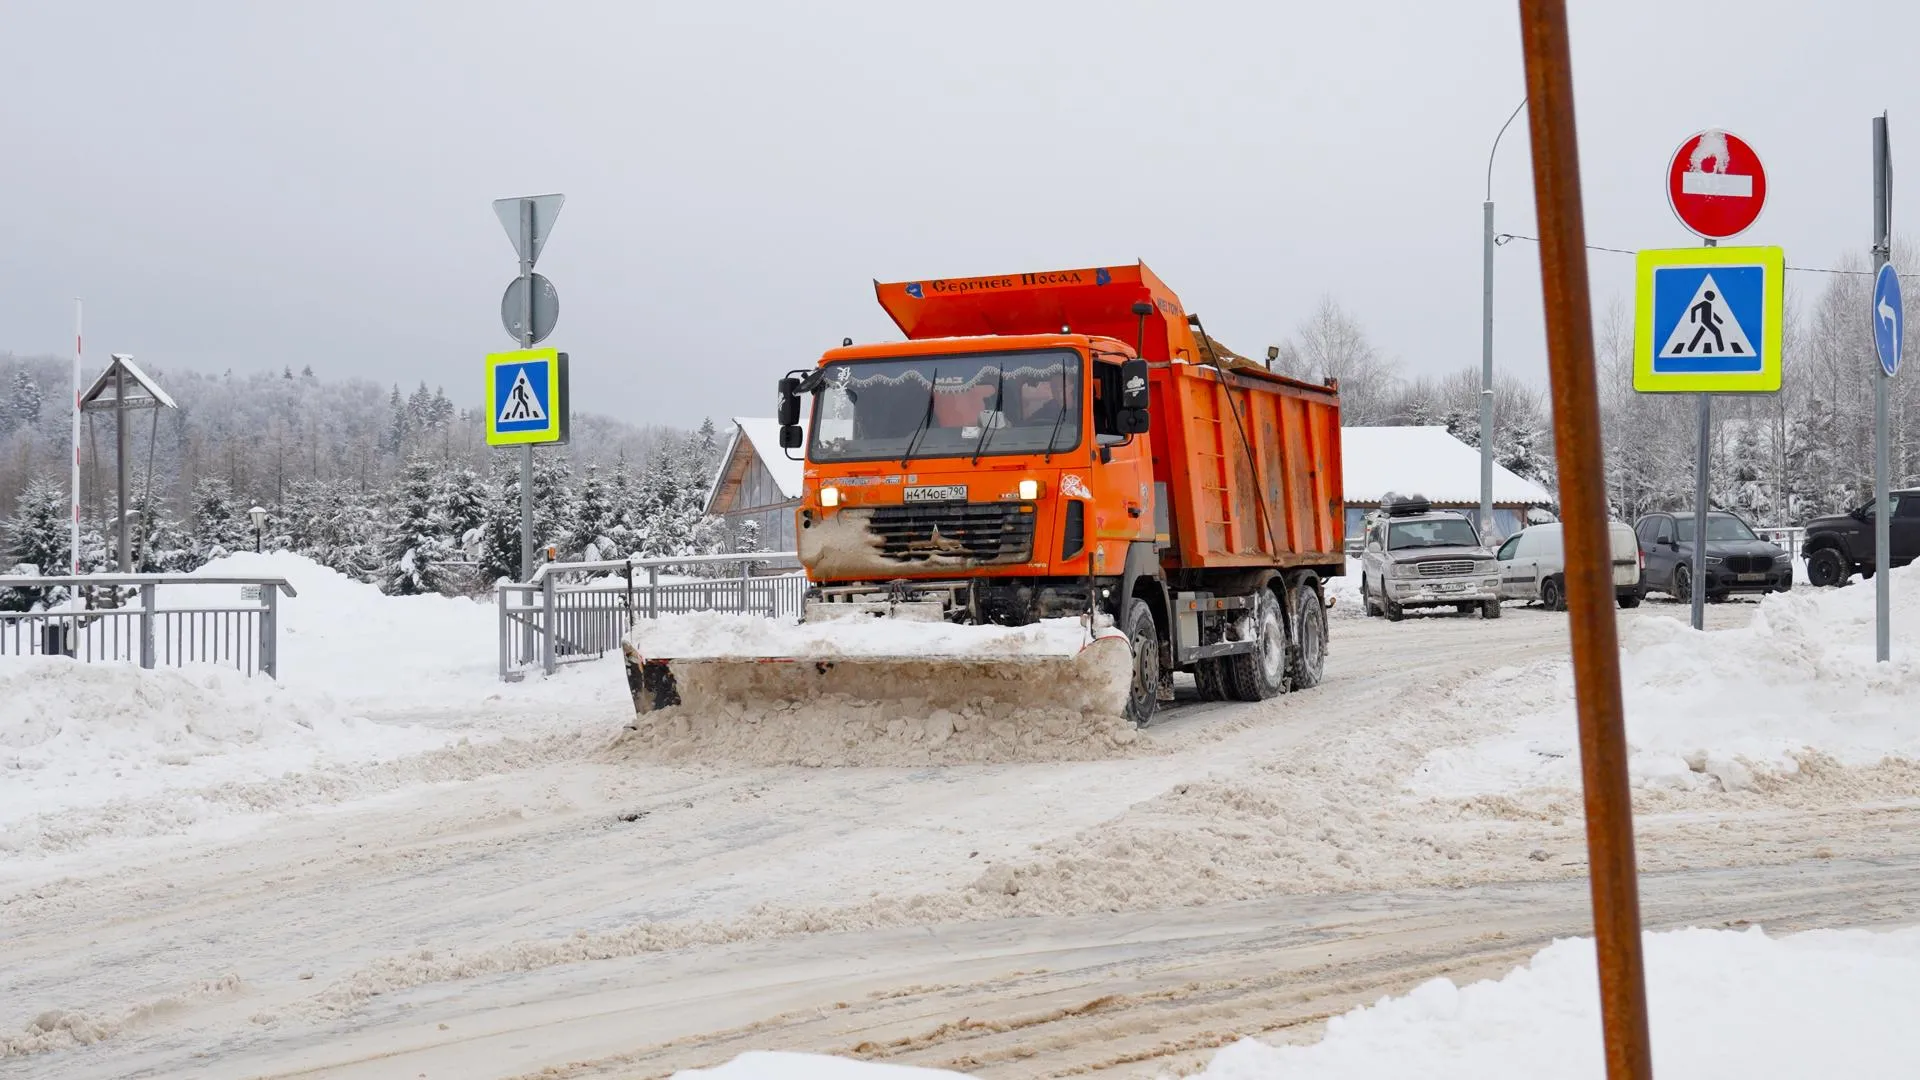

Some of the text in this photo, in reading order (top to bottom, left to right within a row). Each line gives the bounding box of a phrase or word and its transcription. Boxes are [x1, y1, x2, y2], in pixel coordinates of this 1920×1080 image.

[932, 272, 1082, 294] Сергиев Посад
[948, 486, 964, 495] 790
